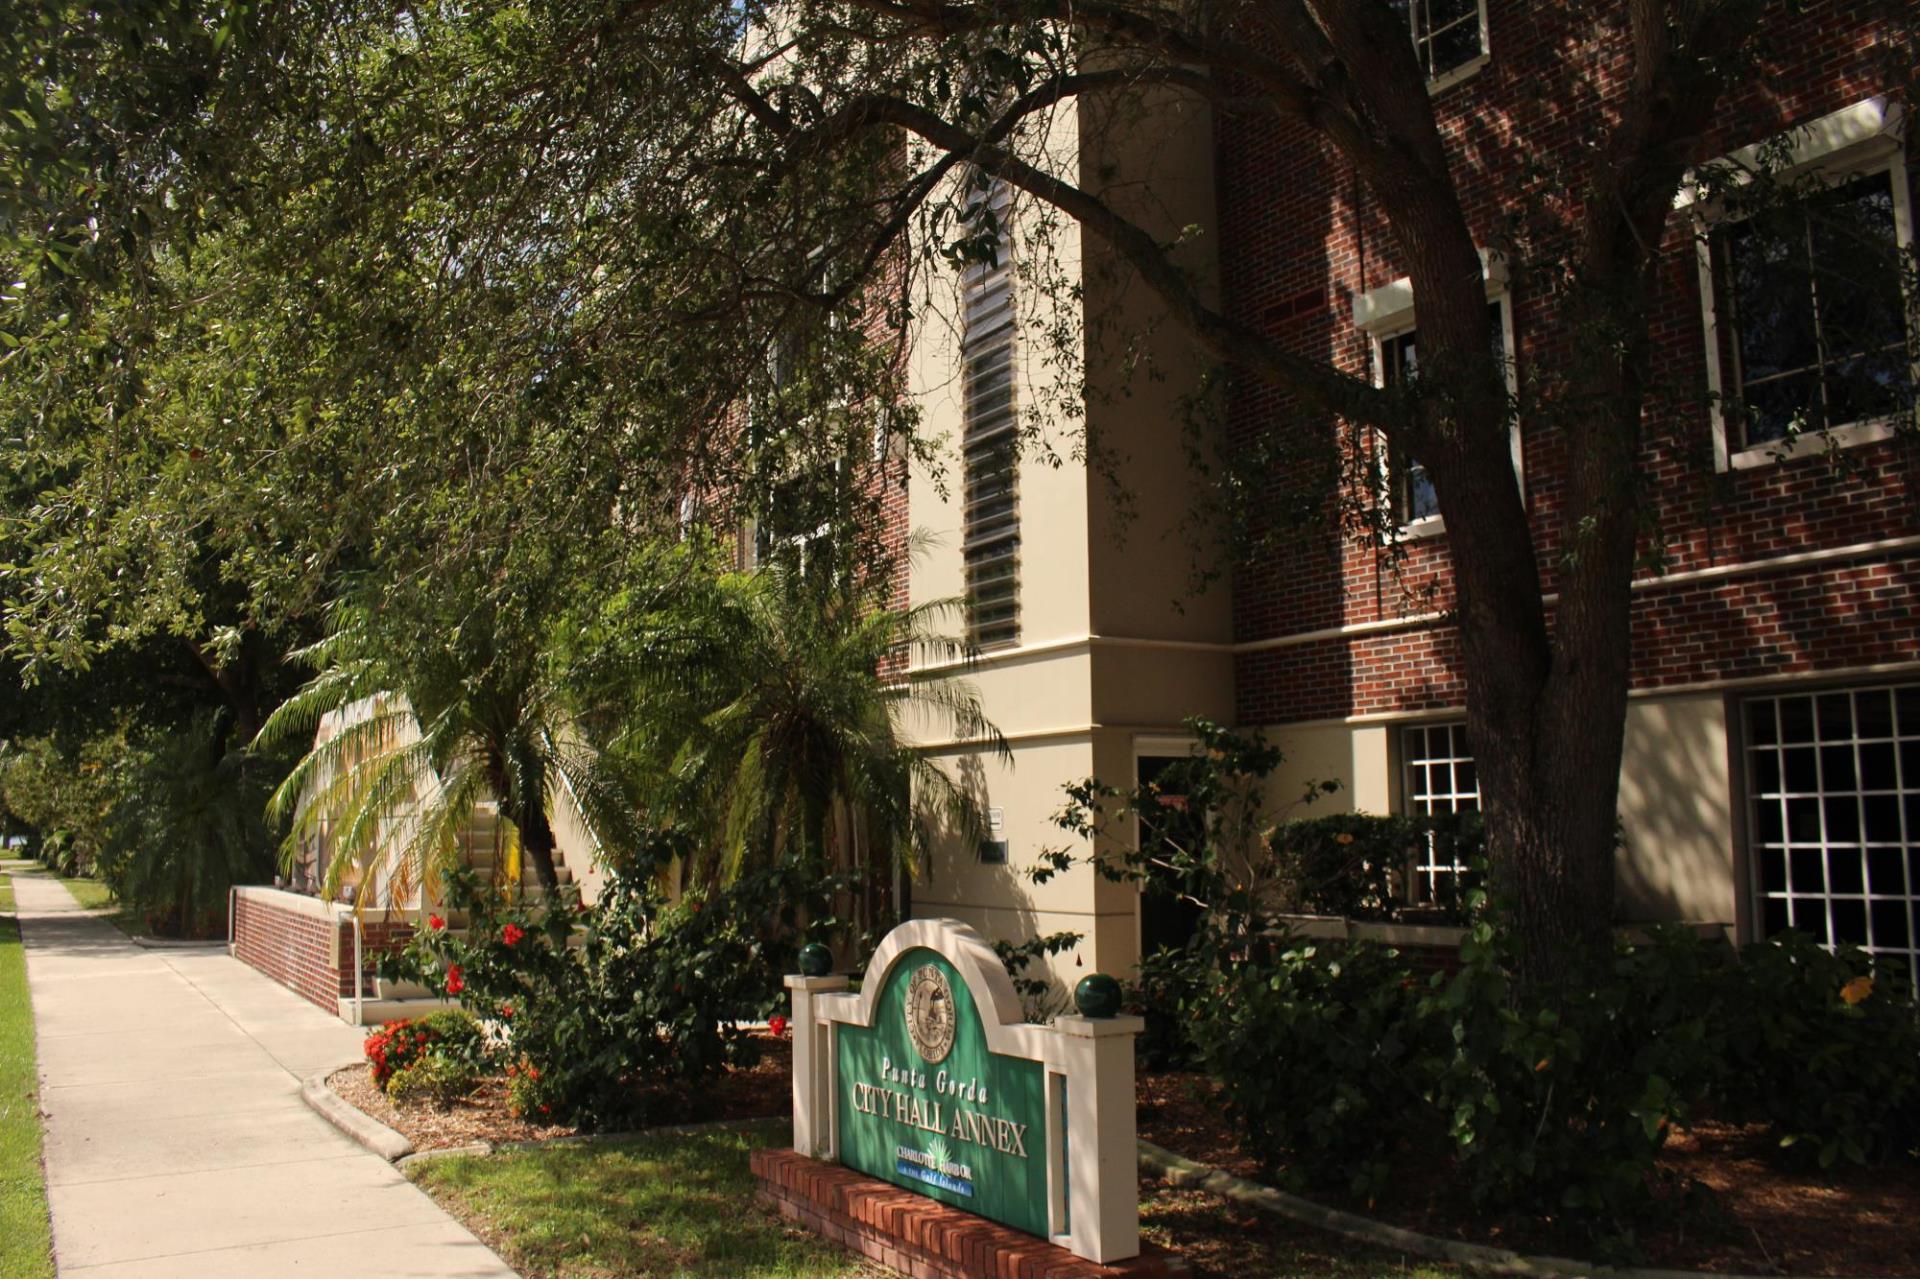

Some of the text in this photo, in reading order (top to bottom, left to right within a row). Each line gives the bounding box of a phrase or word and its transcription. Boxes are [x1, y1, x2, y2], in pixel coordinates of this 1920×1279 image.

[882, 1057, 988, 1104] Punta Gorda
[853, 1082, 1028, 1158] CITY HALL ANNEX
[897, 1145, 936, 1169] CHARLOTTE
[920, 1170, 937, 1186] Gulf
